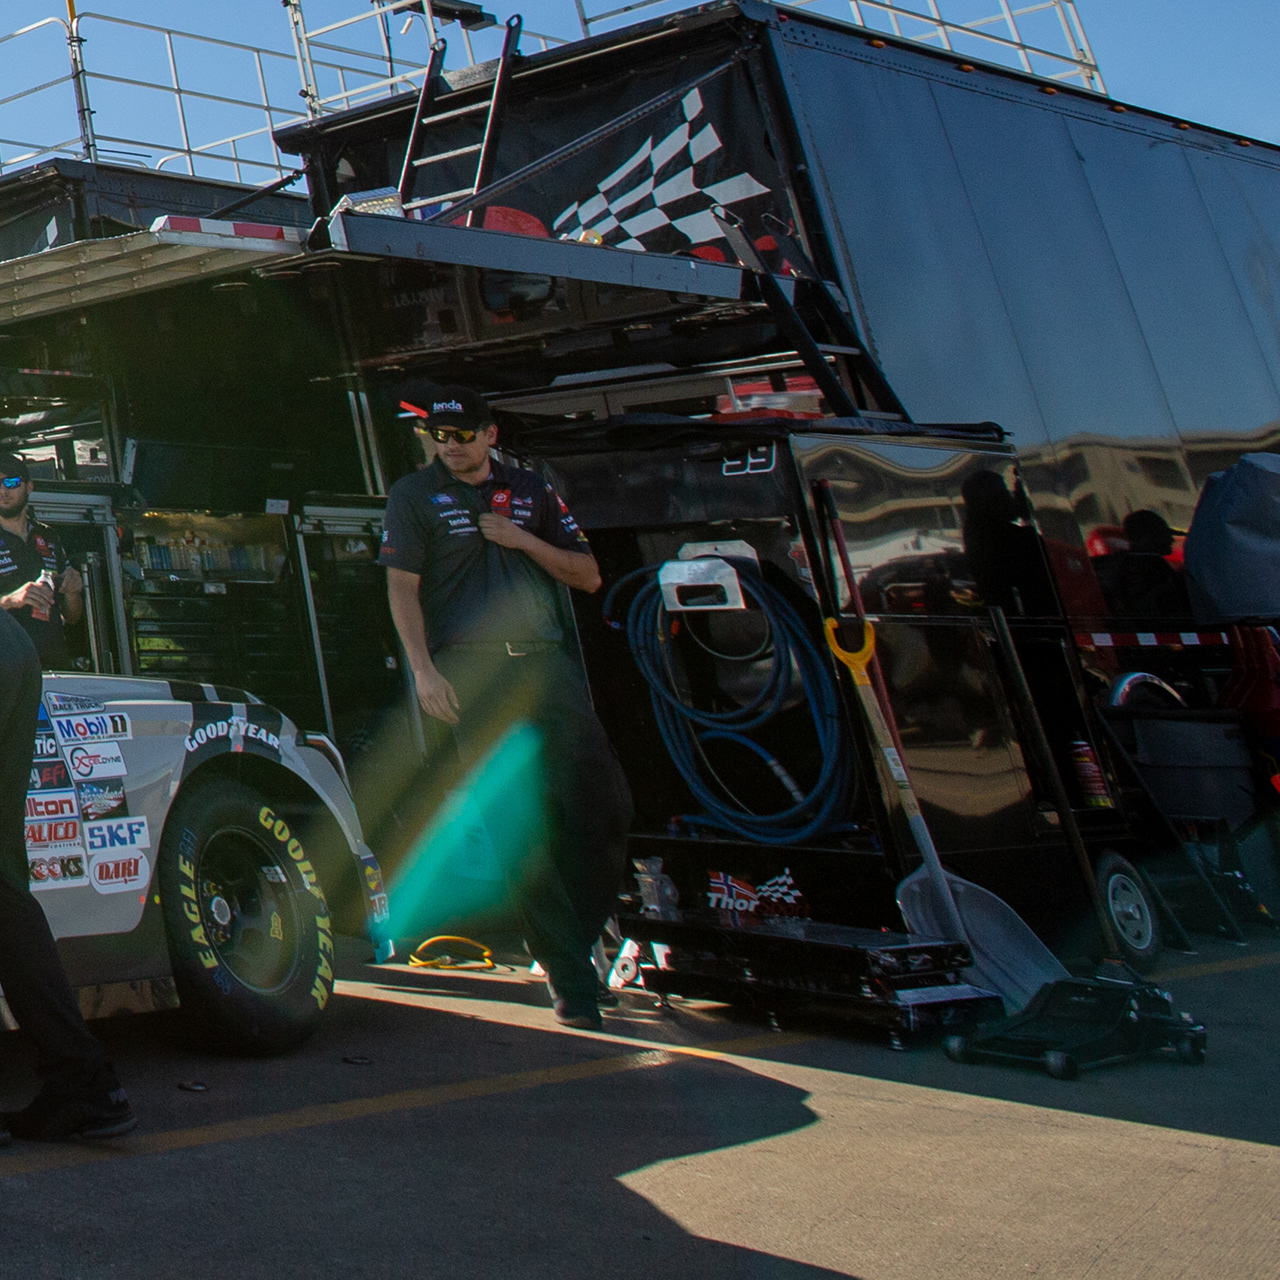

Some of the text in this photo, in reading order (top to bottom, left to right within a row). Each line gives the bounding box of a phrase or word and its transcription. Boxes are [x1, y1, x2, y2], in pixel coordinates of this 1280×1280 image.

[433, 400, 463, 411] tenda
[448, 517, 471, 526] tenda
[56, 716, 108, 739] Mobil
[184, 716, 280, 752] GOODYEAR
[34, 737, 57, 755] TIC
[25, 821, 77, 843] ALICO
[88, 821, 145, 850] SKF
[178, 854, 219, 969] EAGLE
